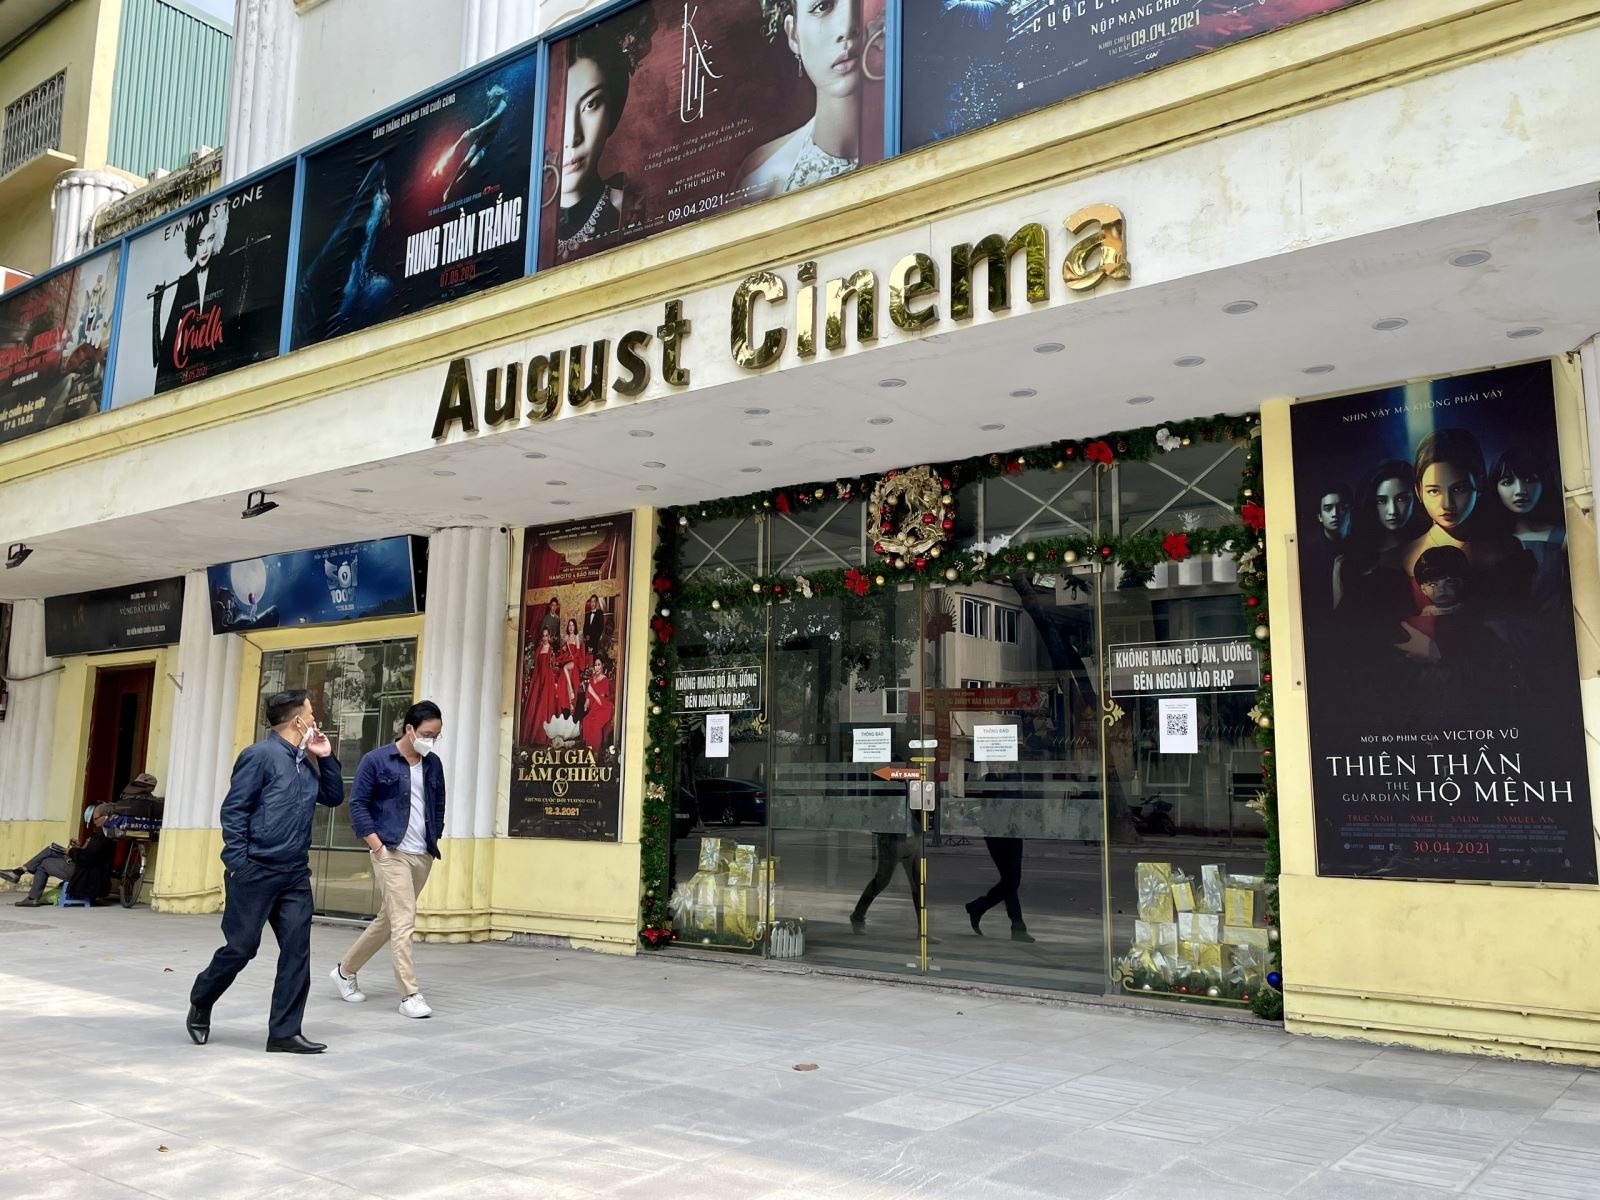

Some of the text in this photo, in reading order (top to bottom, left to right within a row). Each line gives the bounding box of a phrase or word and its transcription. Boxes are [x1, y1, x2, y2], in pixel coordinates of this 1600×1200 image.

[1091, 17, 1114, 35] NỘP
[1118, 3, 1153, 25] MẠNG
[1131, 10, 1200, 48] 09.04.2021
[668, 187, 682, 196] MAI
[700, 171, 726, 186] HUYỀN
[164, 185, 264, 241] EMMA STONE
[668, 195, 724, 222] 09.04.2021
[404, 192, 522, 278] HUNG THẦN TRẮNG
[431, 202, 1131, 440] August Cinema
[173, 304, 223, 369] Cruella
[1116, 640, 1252, 668] KHÔNG MANG ĐỒ ĂN, UỐNG
[675, 668, 757, 690] KHÔNG MANG ĐỒ ĂN, UỐNG
[1133, 668, 1234, 691] BÊN NGOÀI VÀO RẠP
[684, 692, 746, 708] BÊN NGOÀI VÀO RẠP
[1360, 735, 1381, 744] MỘT
[1382, 734, 1394, 744] BỘ
[1421, 732, 1439, 742] CỦA
[1443, 729, 1495, 741] VICTOR
[1499, 727, 1519, 739] VŨ
[532, 746, 596, 765] GÁI GIÀ
[1326, 744, 1522, 777] THIÊN THẦN
[555, 764, 613, 782] CHIÊU
[1342, 793, 1411, 802] GUARDIAN
[1385, 781, 1410, 791] THE
[1416, 776, 1573, 807] HỘ MỆNH
[545, 806, 579, 816] 12.3.2021
[1409, 815, 1436, 823] AMEE
[1412, 840, 1490, 855] 30.04.2021
